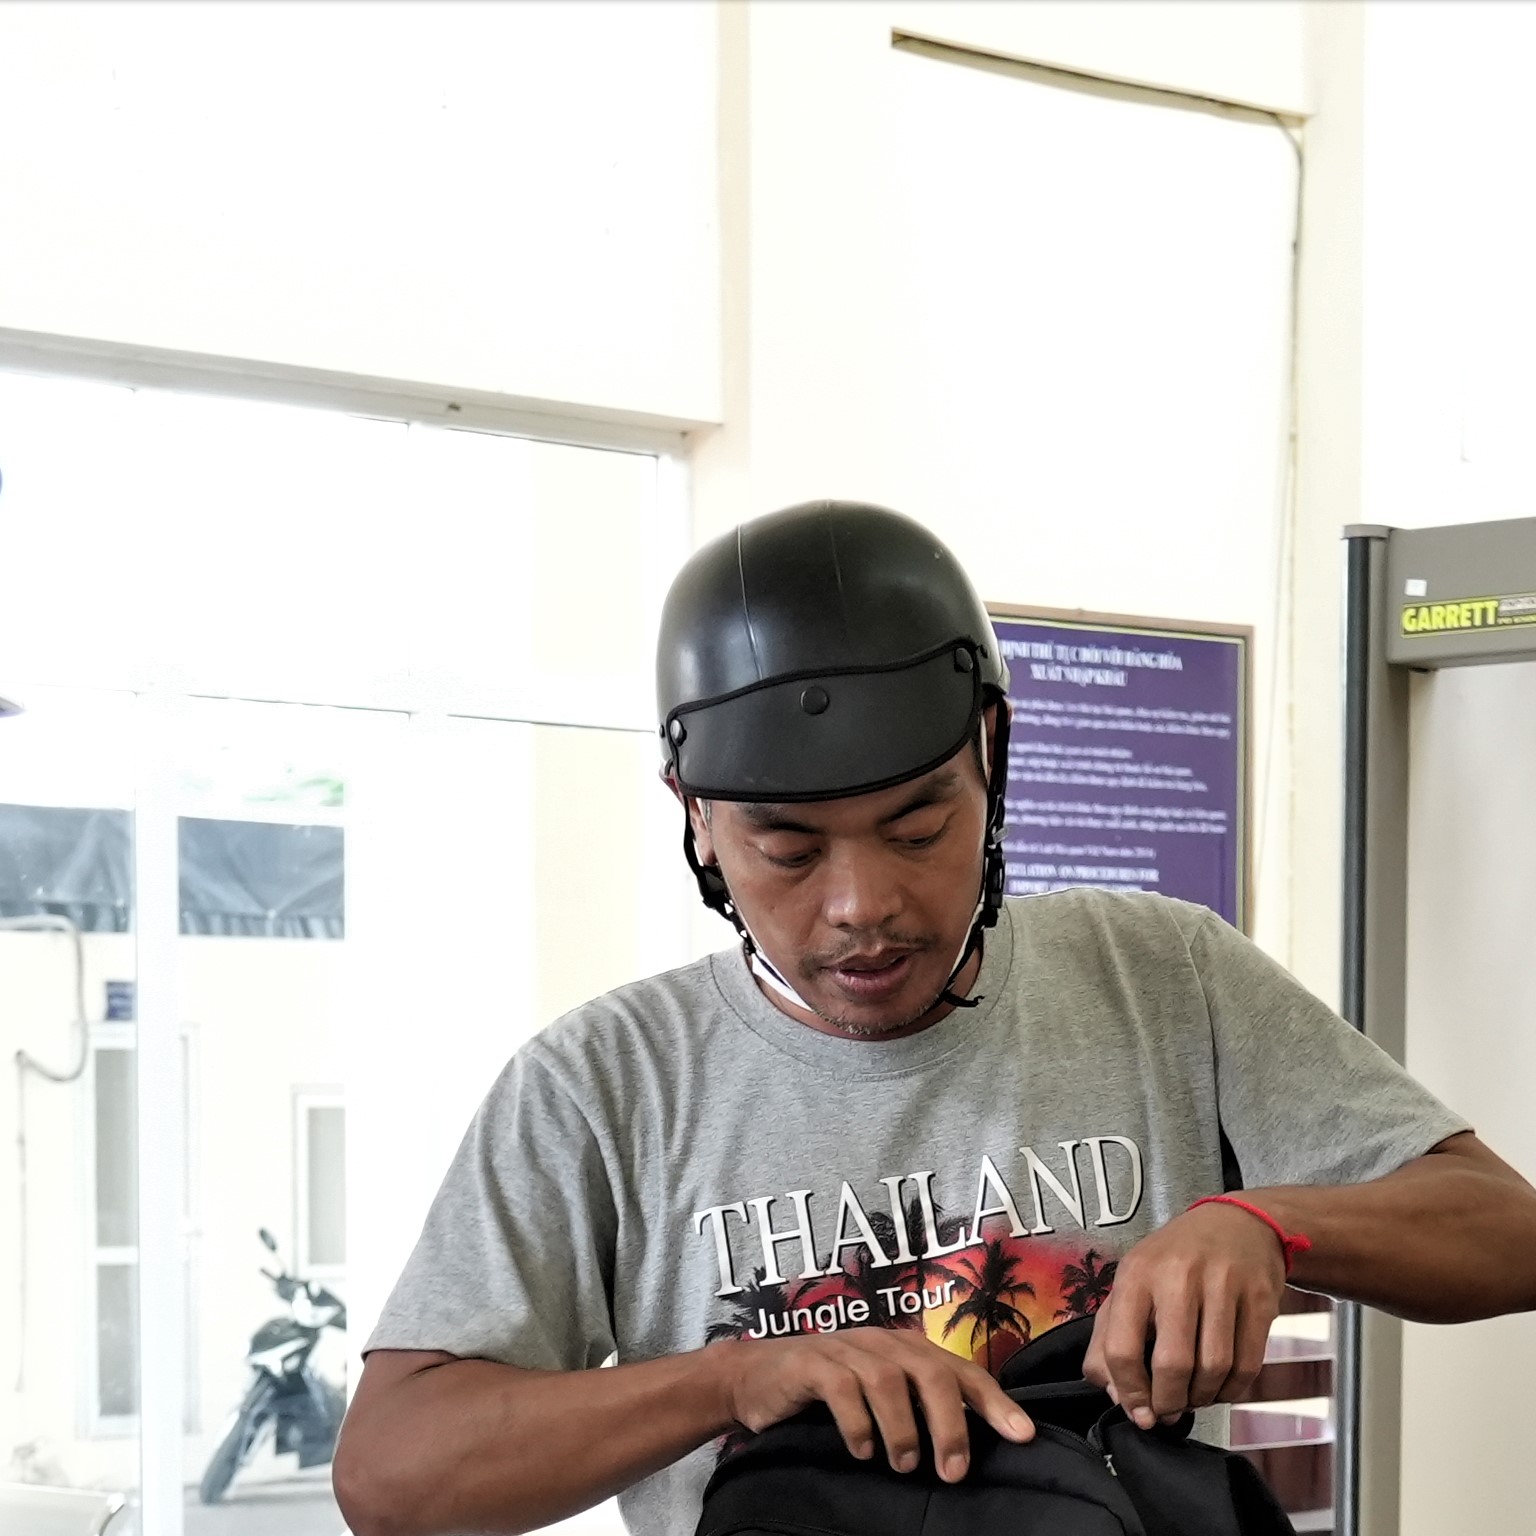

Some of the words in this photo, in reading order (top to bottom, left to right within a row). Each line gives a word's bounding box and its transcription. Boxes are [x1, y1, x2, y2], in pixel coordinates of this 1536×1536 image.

[1402, 600, 1499, 632] GARRETT
[693, 1135, 1146, 1299] THAILAND
[748, 1293, 871, 1340] Jungle
[877, 1278, 957, 1318] Tour
